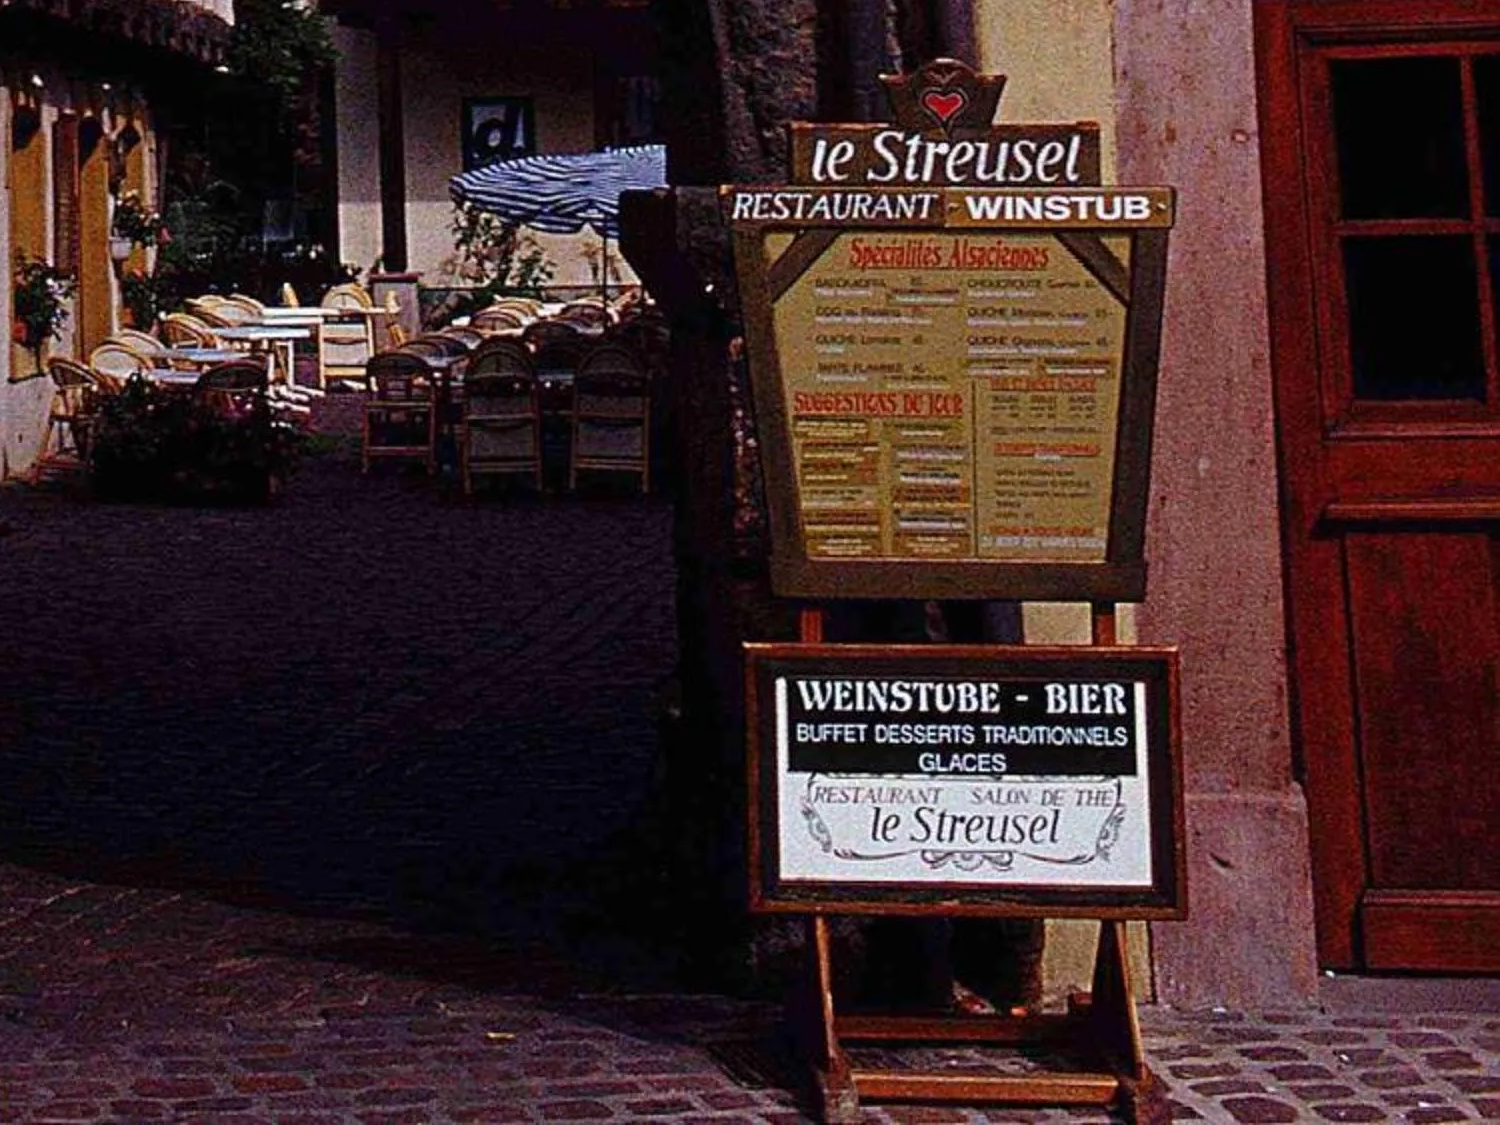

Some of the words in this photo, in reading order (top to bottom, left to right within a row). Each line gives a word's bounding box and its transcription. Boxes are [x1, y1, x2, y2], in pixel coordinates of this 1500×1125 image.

[811, 139, 855, 182] le
[867, 130, 1081, 183] Streusel
[731, 192, 939, 220] RESTAURANT
[964, 194, 1151, 221] WINSTUB
[796, 680, 1001, 714] WEINSTUBE
[1044, 682, 1127, 715] BIER
[796, 722, 869, 743] BUFFET
[874, 723, 975, 745] DESSERTS
[982, 725, 1129, 747] TRADITIONNELS
[918, 752, 1007, 772] GLACES
[812, 786, 944, 804] RESTAURANT
[971, 787, 1031, 805] SALON
[1041, 788, 1065, 806] DE
[871, 806, 901, 842] le
[909, 806, 1060, 844] Streusel
